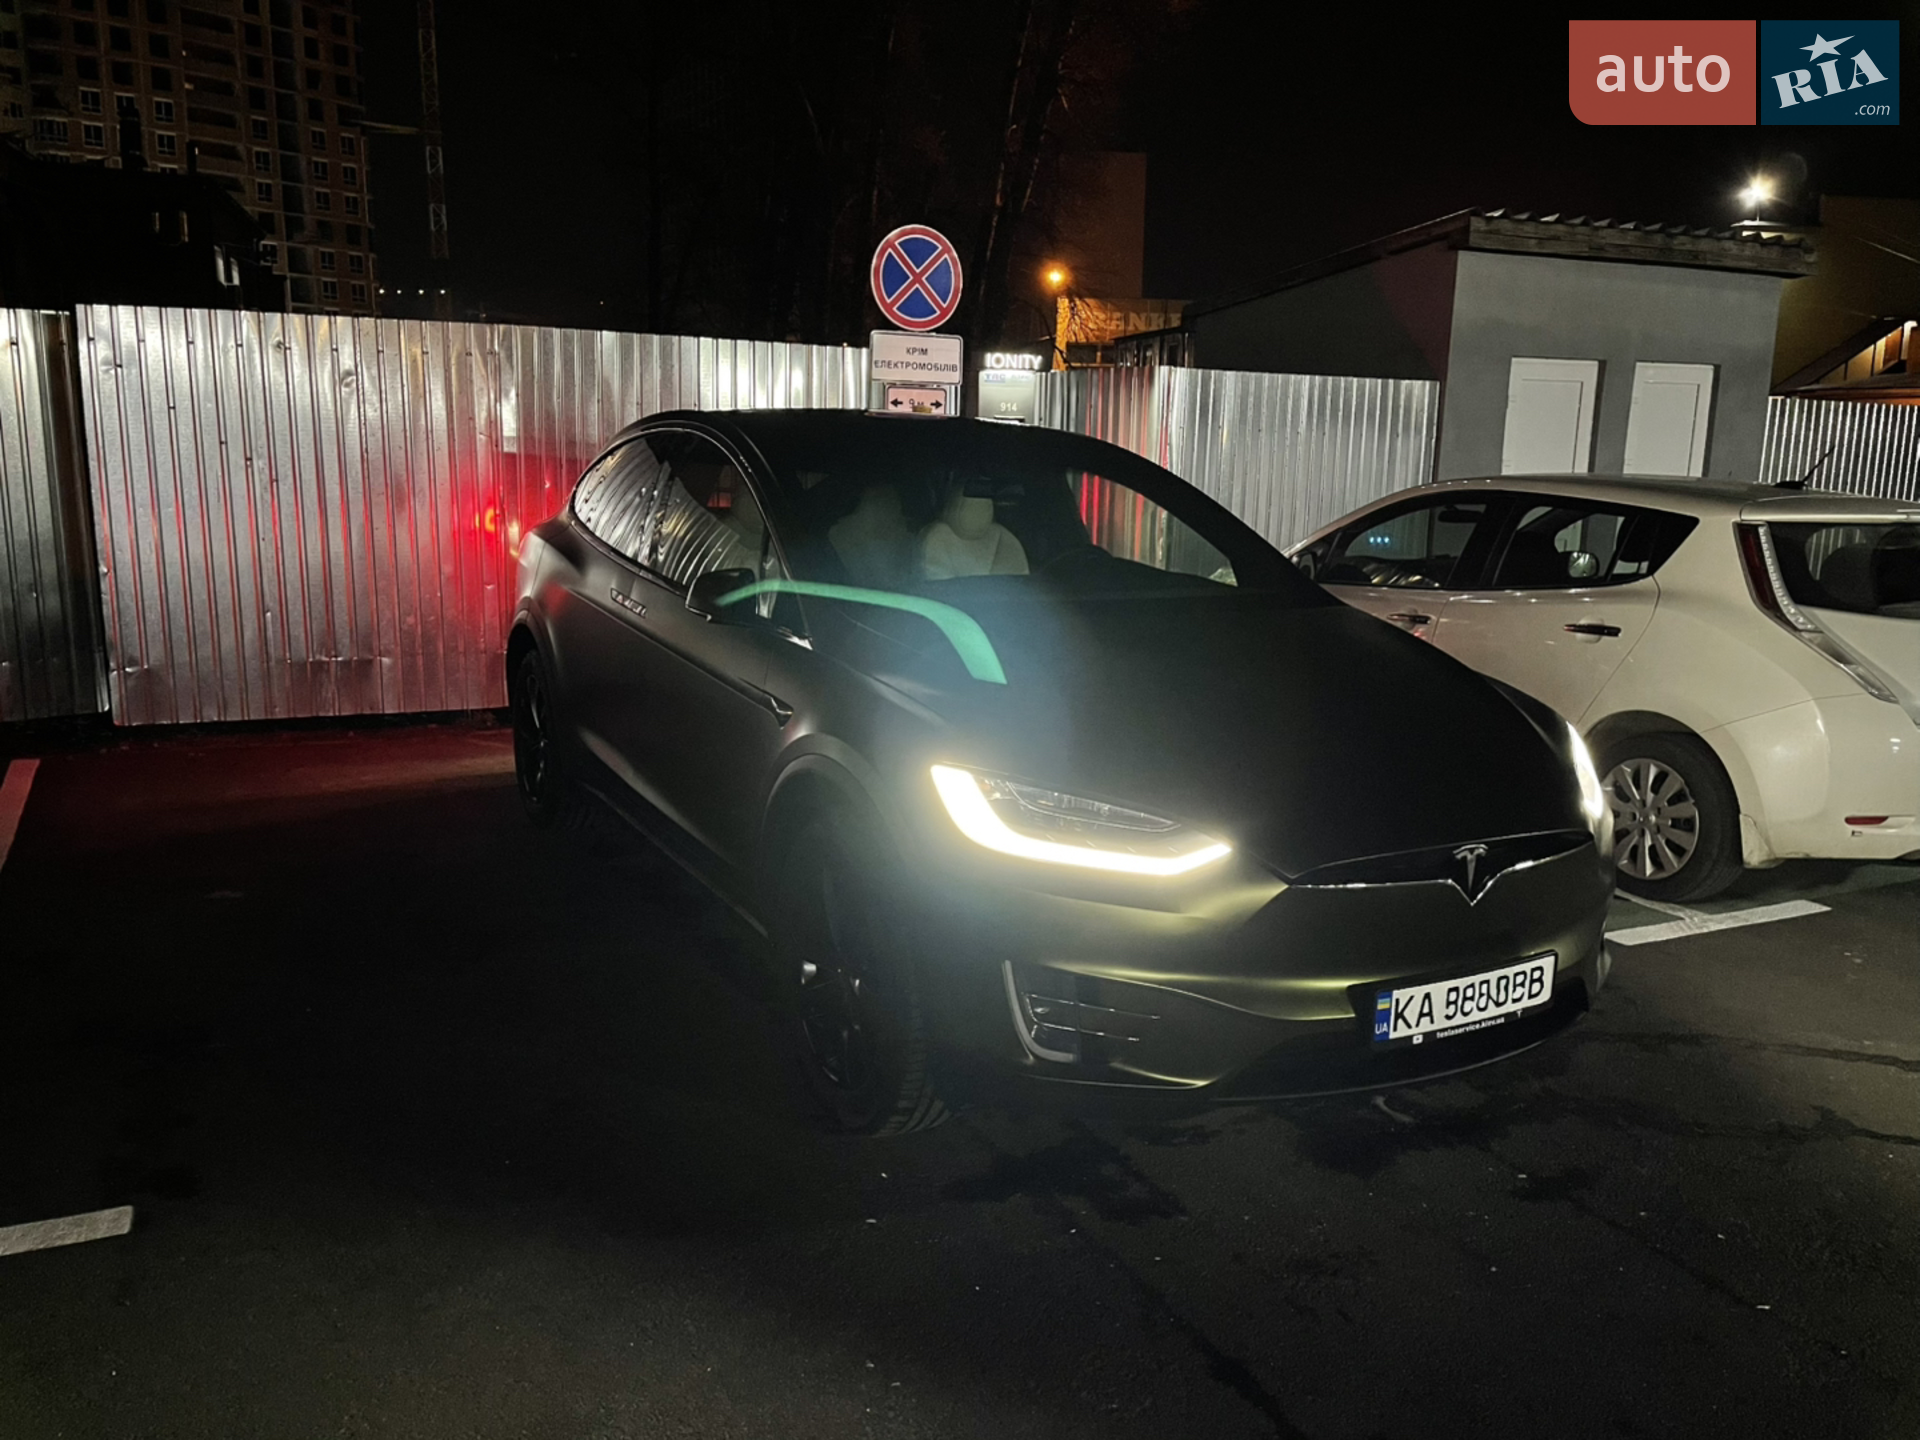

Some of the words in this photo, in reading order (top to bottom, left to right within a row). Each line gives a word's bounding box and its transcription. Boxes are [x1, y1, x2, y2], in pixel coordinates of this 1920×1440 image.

[906, 347, 928, 356] КРІМ
[985, 352, 1043, 370] IONITY
[1000, 402, 1018, 412] 914
[1393, 991, 1435, 1033] KA
[1375, 1023, 1389, 1035] UA
